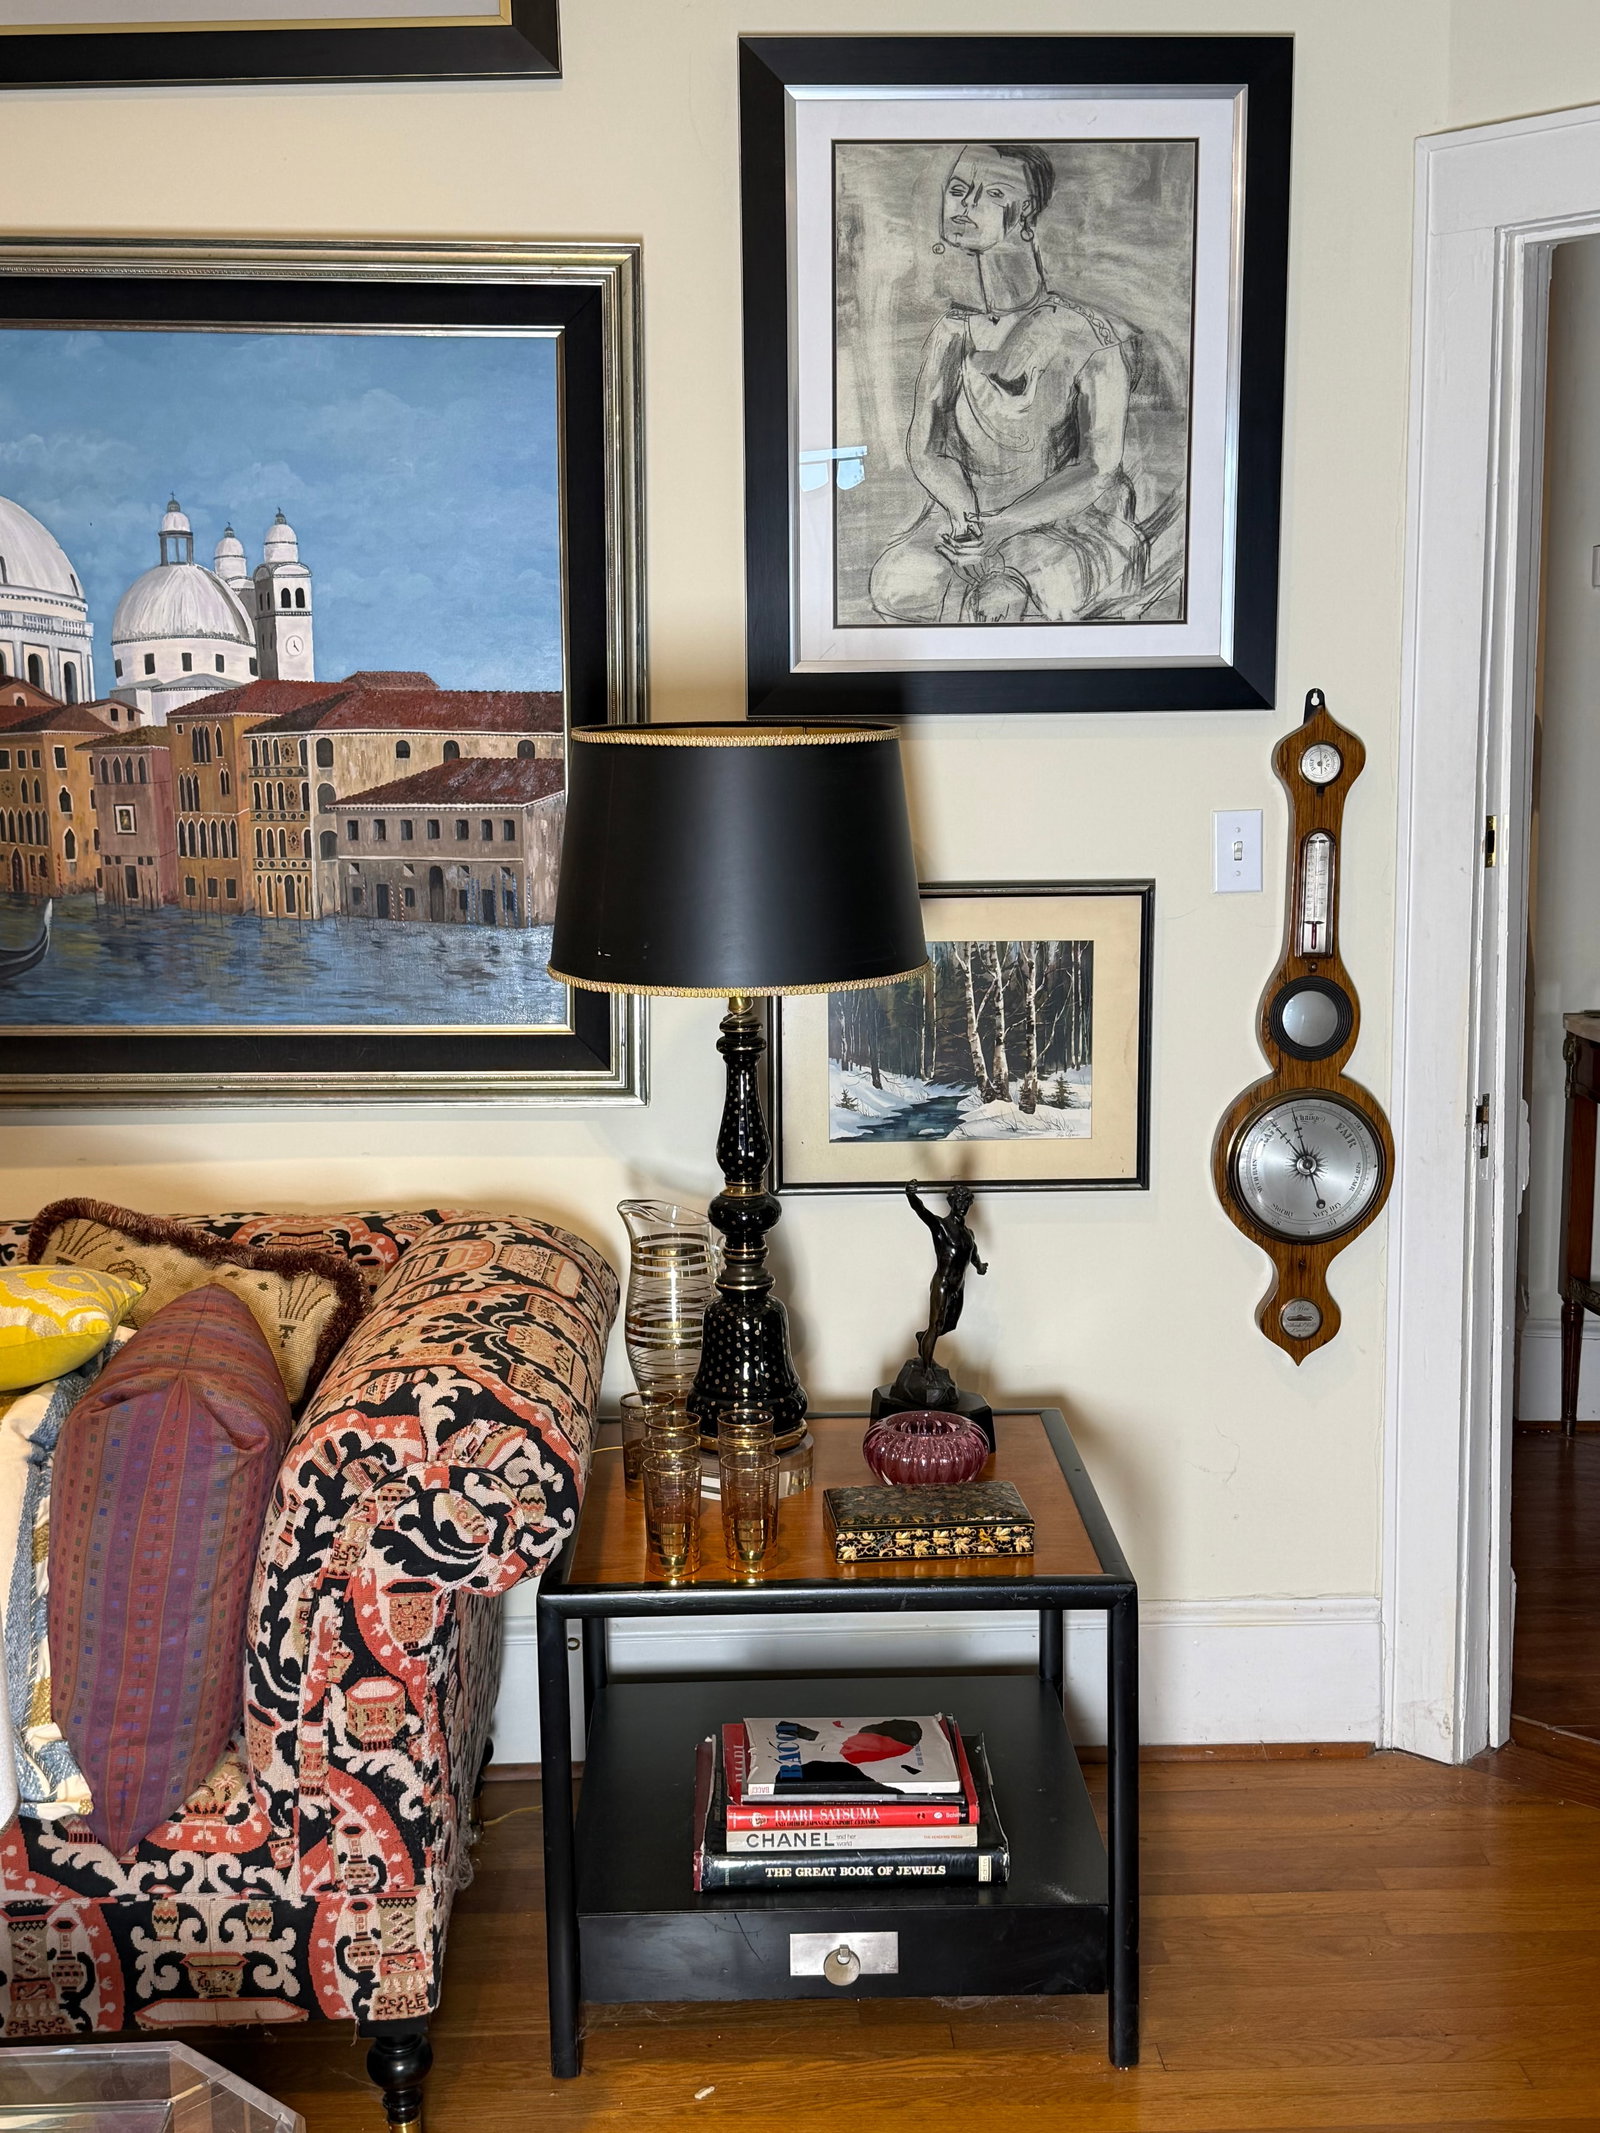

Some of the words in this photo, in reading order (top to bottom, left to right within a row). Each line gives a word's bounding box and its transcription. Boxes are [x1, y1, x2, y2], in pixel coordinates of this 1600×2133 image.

[1335, 1122, 1357, 1149] FAIR
[775, 1808, 813, 1822] IMARI
[820, 1807, 880, 1821] SATSUMA
[746, 1831, 835, 1848] CHANEL
[765, 1866, 792, 1878] THE
[795, 1866, 837, 1877] GREAT
[840, 1866, 873, 1877] BOOK
[877, 1866, 894, 1876] OF
[896, 1865, 946, 1876] JEWELS
